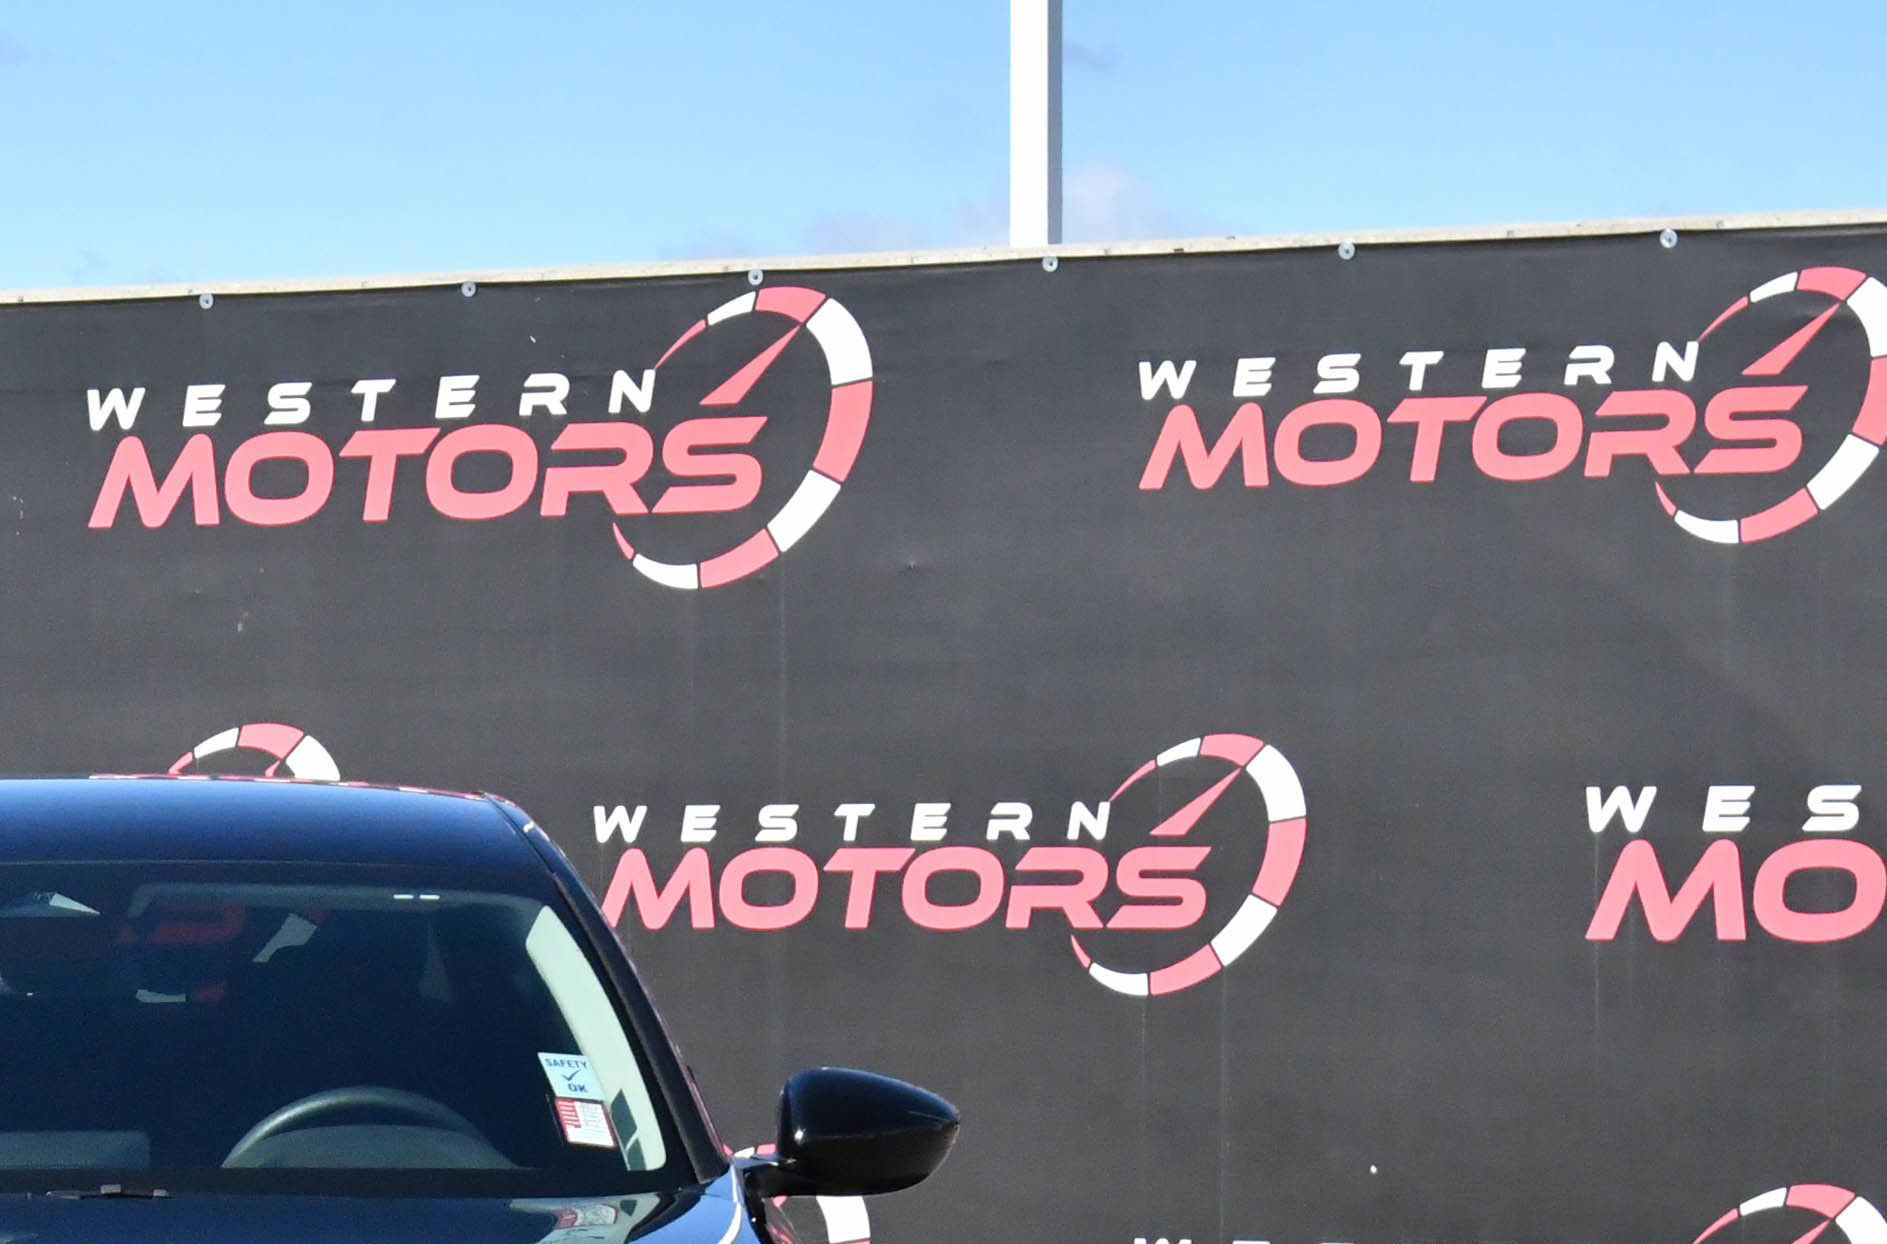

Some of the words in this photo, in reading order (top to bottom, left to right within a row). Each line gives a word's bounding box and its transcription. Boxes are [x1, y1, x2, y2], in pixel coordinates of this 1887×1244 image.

[87, 369, 655, 431] WESTERN
[1139, 341, 1699, 399] WESTERN
[1138, 385, 1808, 489] MOTORS
[87, 415, 768, 529] MOTORS
[592, 801, 1111, 843] WESTERN
[600, 846, 1211, 930] MOTORS
[544, 1058, 588, 1068] SAFETY
[568, 1083, 588, 1093] OK
